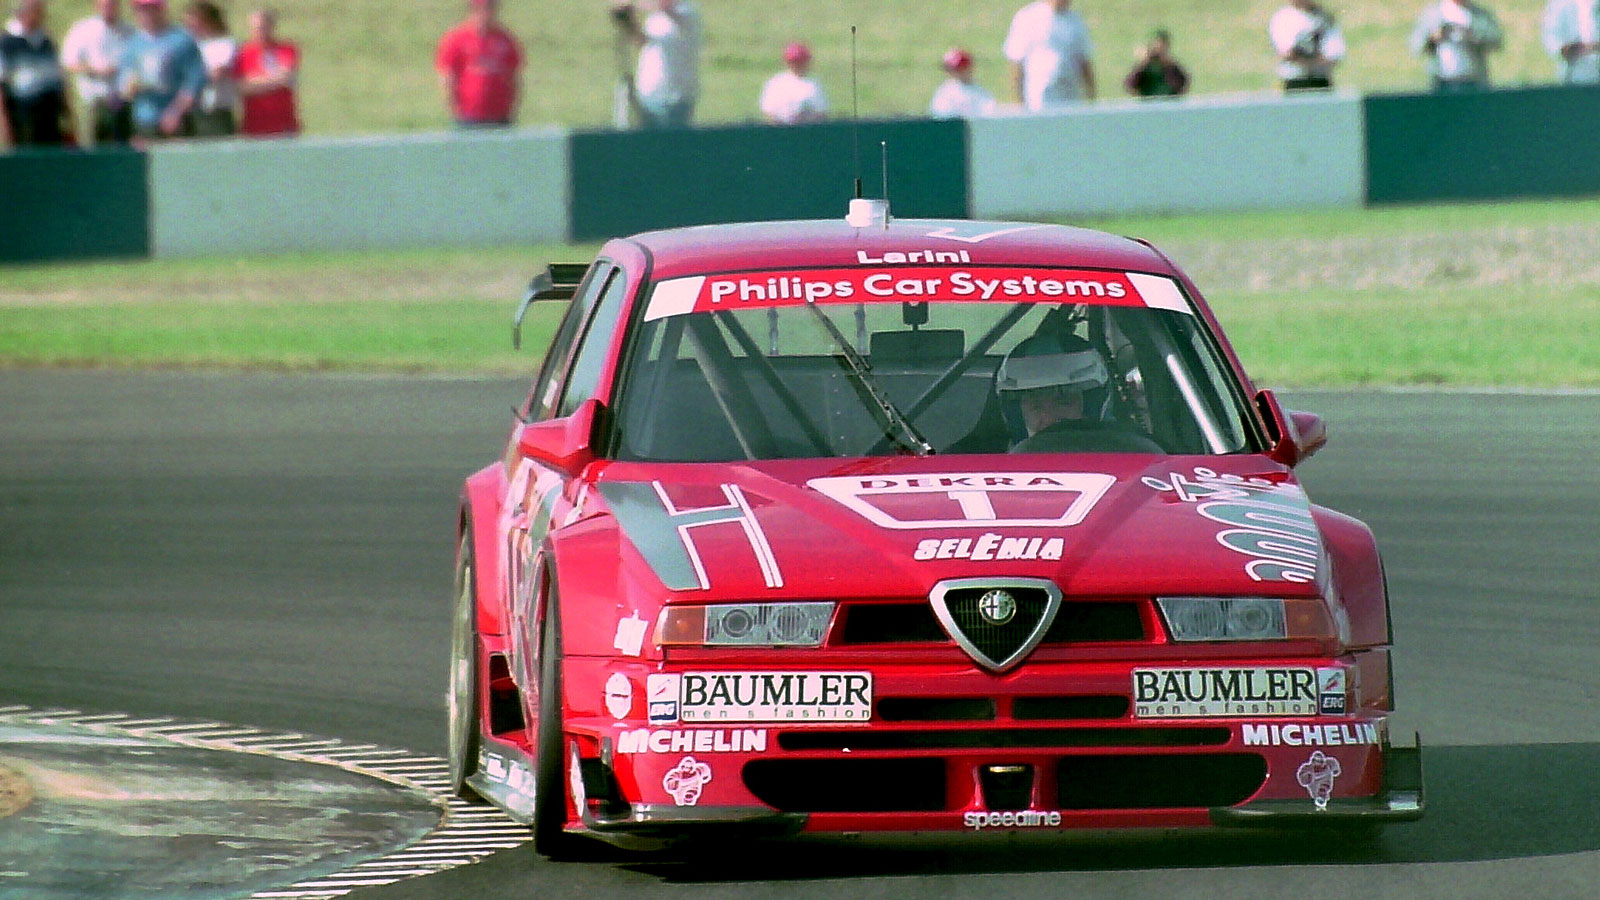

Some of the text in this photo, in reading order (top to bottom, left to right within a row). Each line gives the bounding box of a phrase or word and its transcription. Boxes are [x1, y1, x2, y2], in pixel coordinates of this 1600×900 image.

[857, 250, 970, 265] Larini
[711, 272, 1125, 303] Philips Car Systems
[860, 477, 1063, 489] DEKRA
[947, 490, 996, 520] 1
[682, 675, 870, 706] BÄUMLER
[1135, 670, 1316, 702] BÄUMLER
[774, 706, 870, 718] fashion
[1225, 701, 1316, 715] fashion
[1322, 697, 1344, 709] ERG
[1241, 724, 1378, 746] MICHELIN
[963, 810, 1062, 831] speedline
